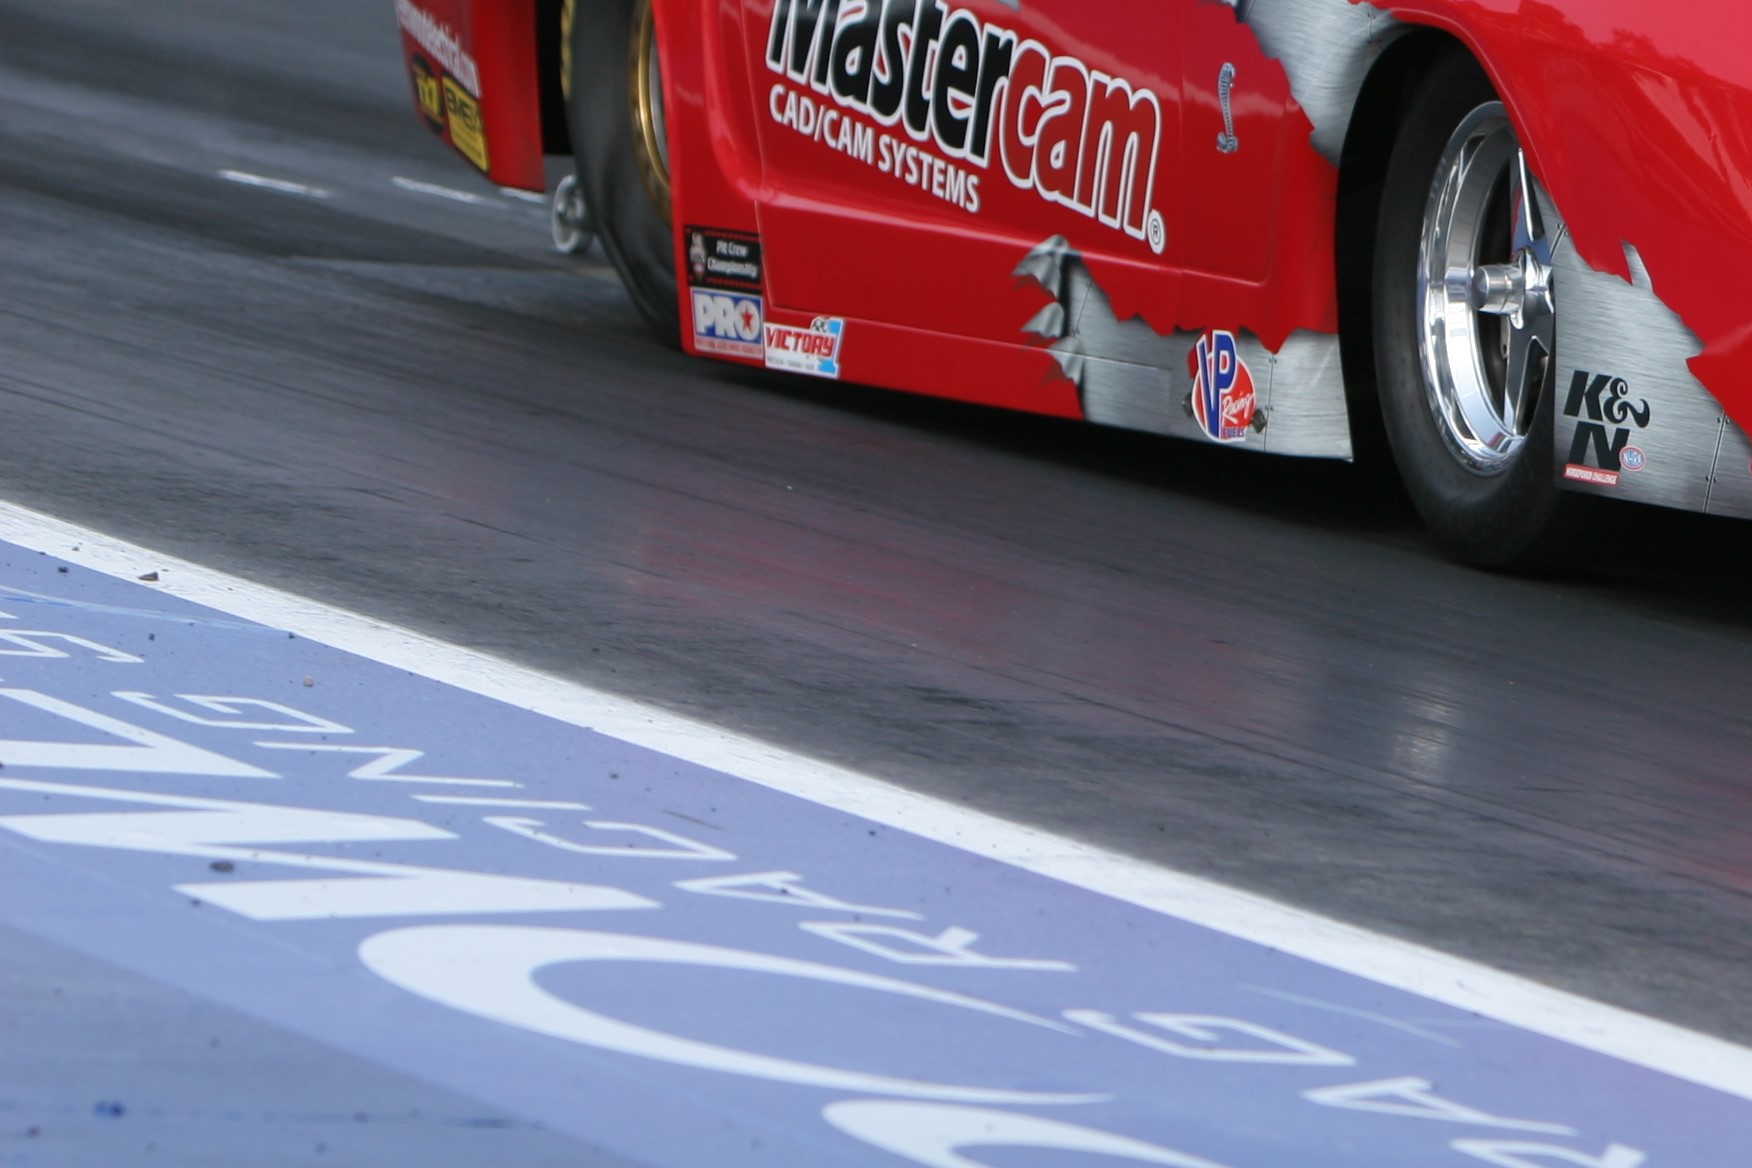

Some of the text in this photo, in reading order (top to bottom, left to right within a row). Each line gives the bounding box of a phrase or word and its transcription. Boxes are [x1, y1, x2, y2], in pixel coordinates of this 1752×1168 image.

[768, 83, 981, 214] CAD/CAM SYSTEMS
[693, 293, 761, 341] PRO
[765, 326, 835, 358] VICTORY
[1196, 329, 1237, 440] VP
[1222, 391, 1255, 426] Racing
